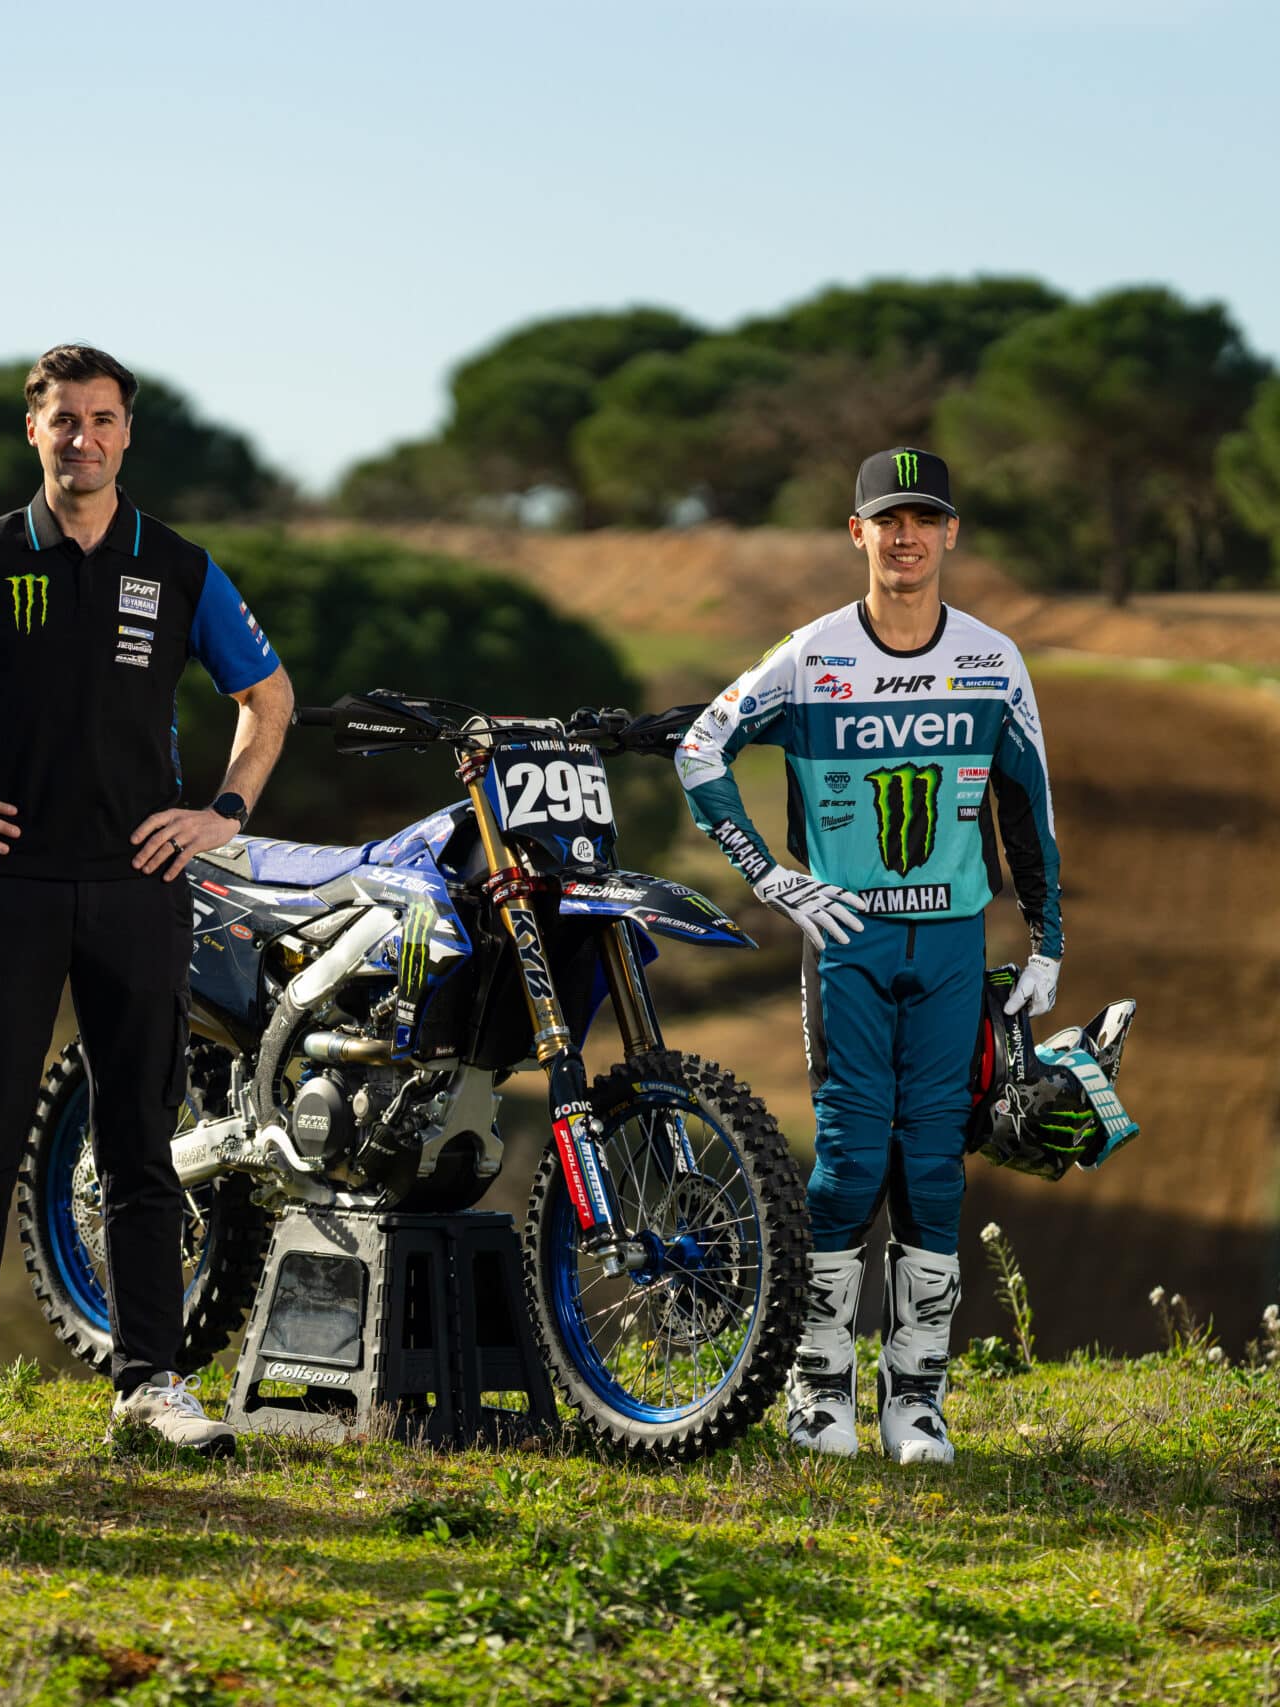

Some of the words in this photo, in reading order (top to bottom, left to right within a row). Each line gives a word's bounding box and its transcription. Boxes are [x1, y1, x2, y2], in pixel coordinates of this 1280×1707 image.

[124, 582, 156, 596] VHR
[954, 653, 1003, 662] BLU
[957, 661, 1004, 669] CRU
[874, 675, 936, 694] VHR
[347, 721, 406, 734] POLISPORT
[835, 712, 974, 750] raven
[530, 740, 566, 752] YAMAHA
[505, 760, 614, 829] 295
[763, 876, 809, 898] FIVE
[861, 887, 948, 912] YAMAHA
[509, 907, 553, 1000] KYB
[565, 1144, 591, 1219] POLISPORT
[580, 1140, 608, 1217] MICHELIN
[272, 1362, 351, 1386] Polisport
